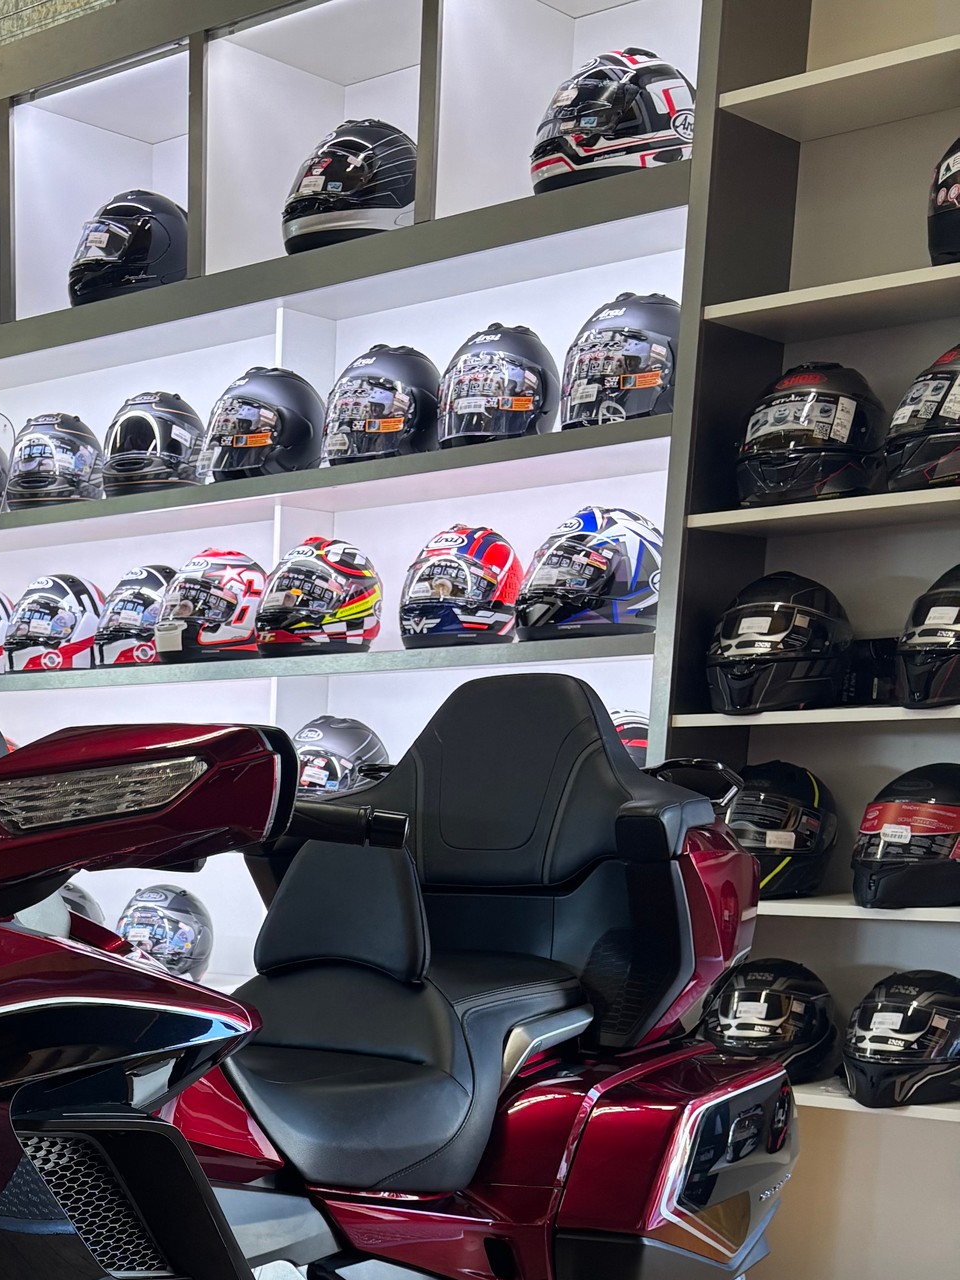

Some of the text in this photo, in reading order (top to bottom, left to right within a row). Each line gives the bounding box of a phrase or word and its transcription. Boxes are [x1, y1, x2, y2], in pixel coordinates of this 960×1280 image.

[591, 307, 626, 322] Arai
[468, 333, 502, 346] Arai
[433, 535, 460, 544] Arai
[288, 548, 310, 557] Arai
